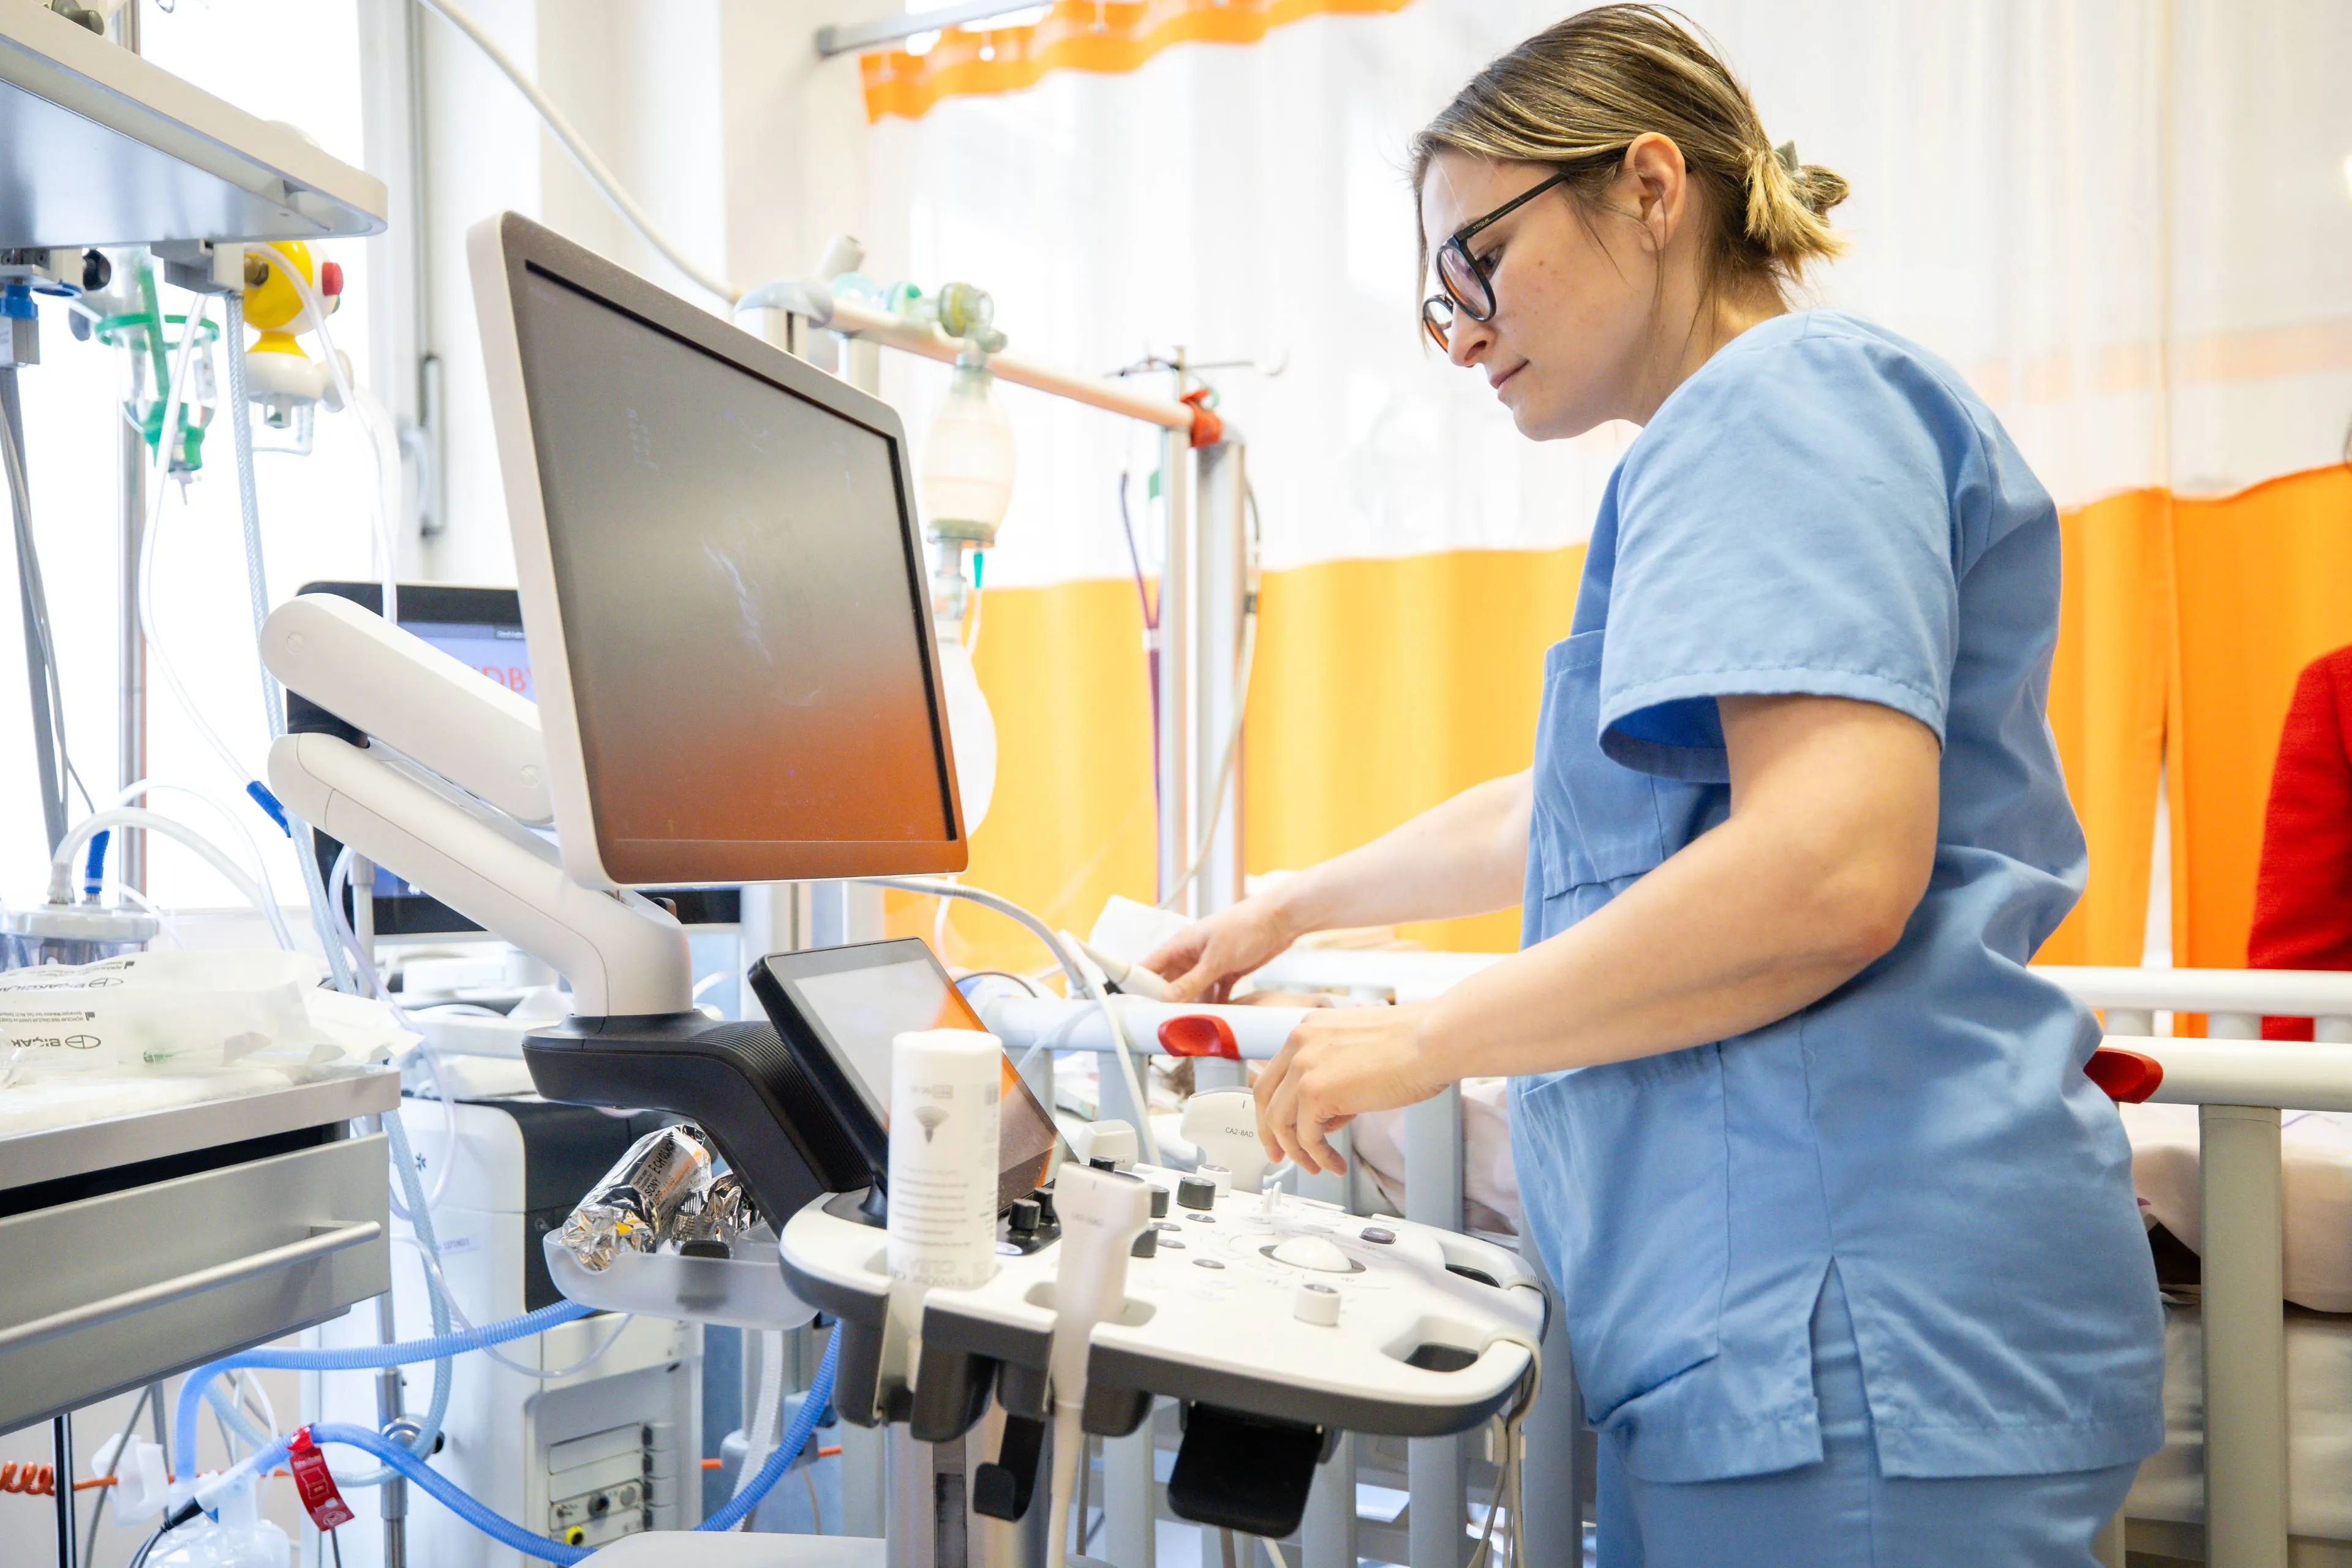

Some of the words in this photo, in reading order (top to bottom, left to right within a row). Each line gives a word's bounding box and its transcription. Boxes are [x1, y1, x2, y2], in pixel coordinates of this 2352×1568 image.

[1472, 218, 1490, 229] VOGUE
[1225, 1127, 1254, 1137] CA2-8AD
[644, 1177, 661, 1197] SONY
